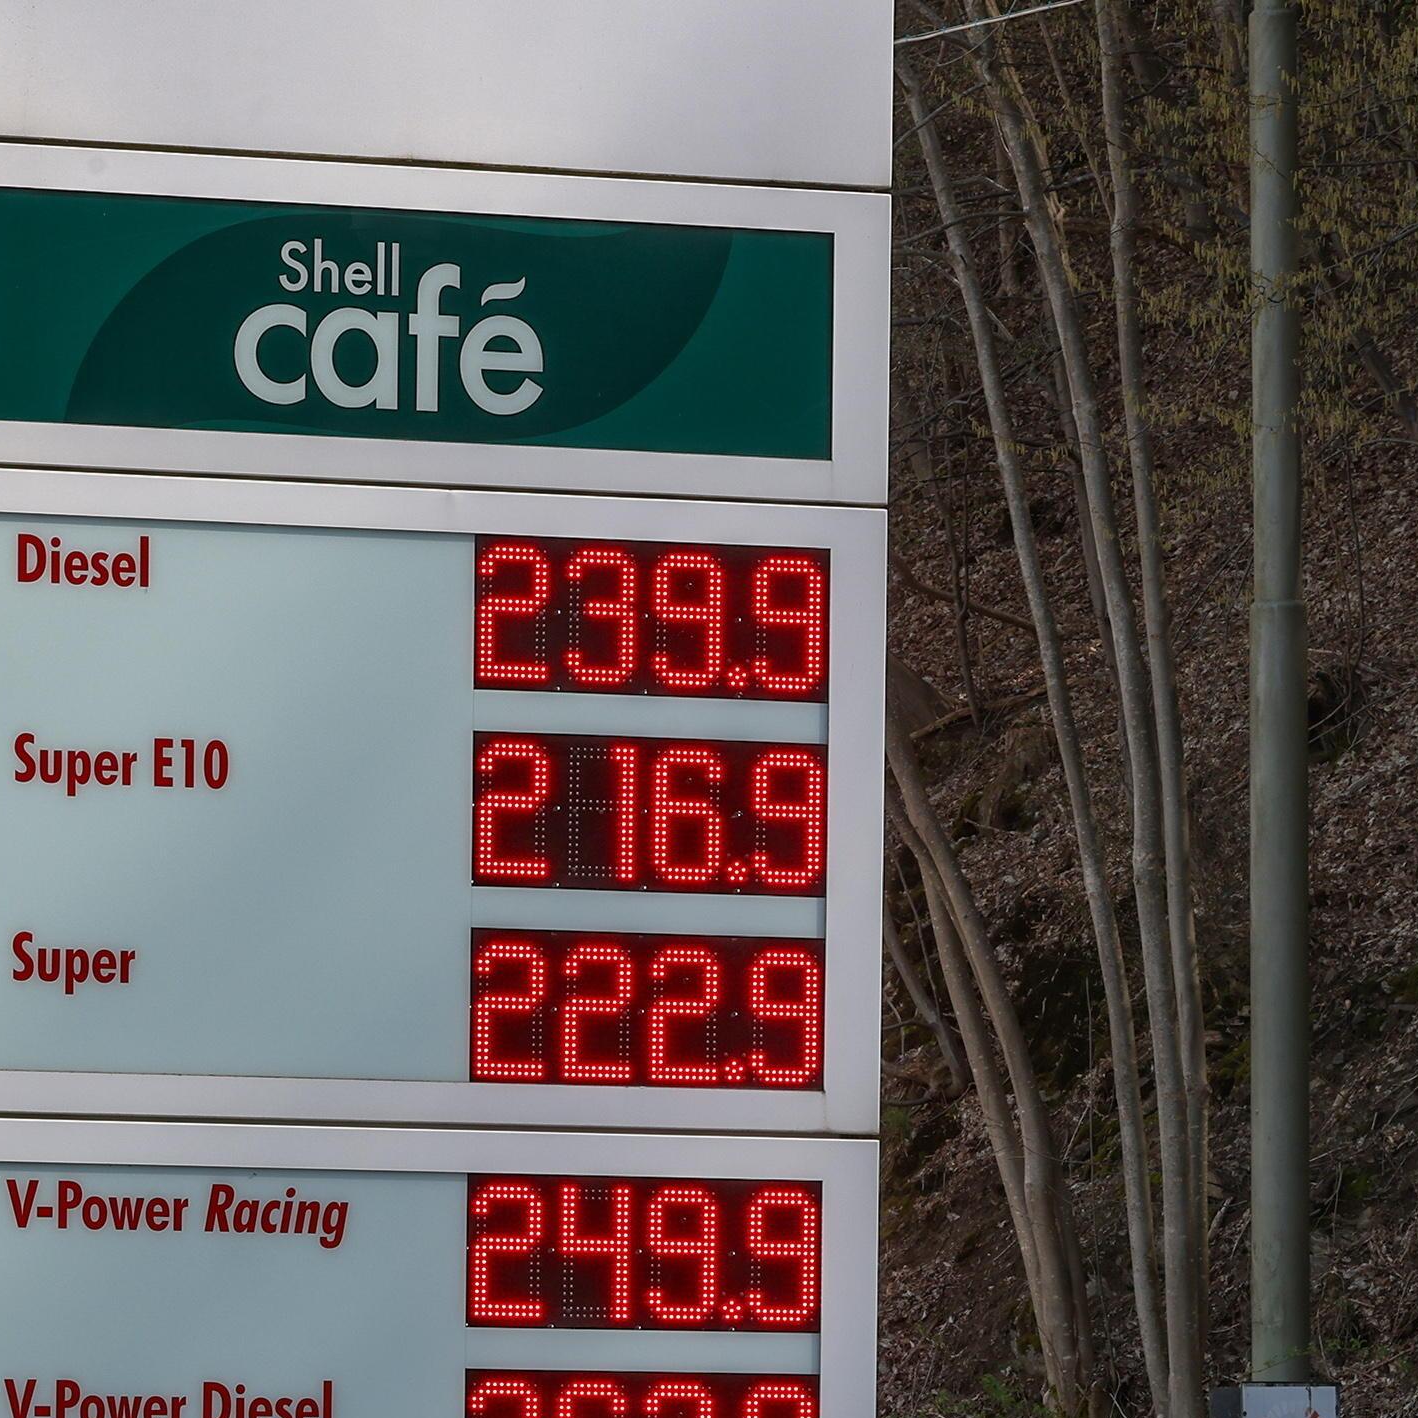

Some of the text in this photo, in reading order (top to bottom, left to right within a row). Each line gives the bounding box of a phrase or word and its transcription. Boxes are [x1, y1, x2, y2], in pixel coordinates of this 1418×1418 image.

[279, 238, 400, 297] Shell
[233, 262, 544, 416] café
[16, 533, 150, 589] Diesel
[478, 544, 824, 693] 239.9
[14, 732, 229, 796] Super E10
[477, 741, 824, 887] 216.9
[13, 931, 135, 994] Super
[473, 942, 821, 1086] 222.9
[6, 1179, 349, 1249] V-Power Racing
[470, 1184, 819, 1323] 249.9
